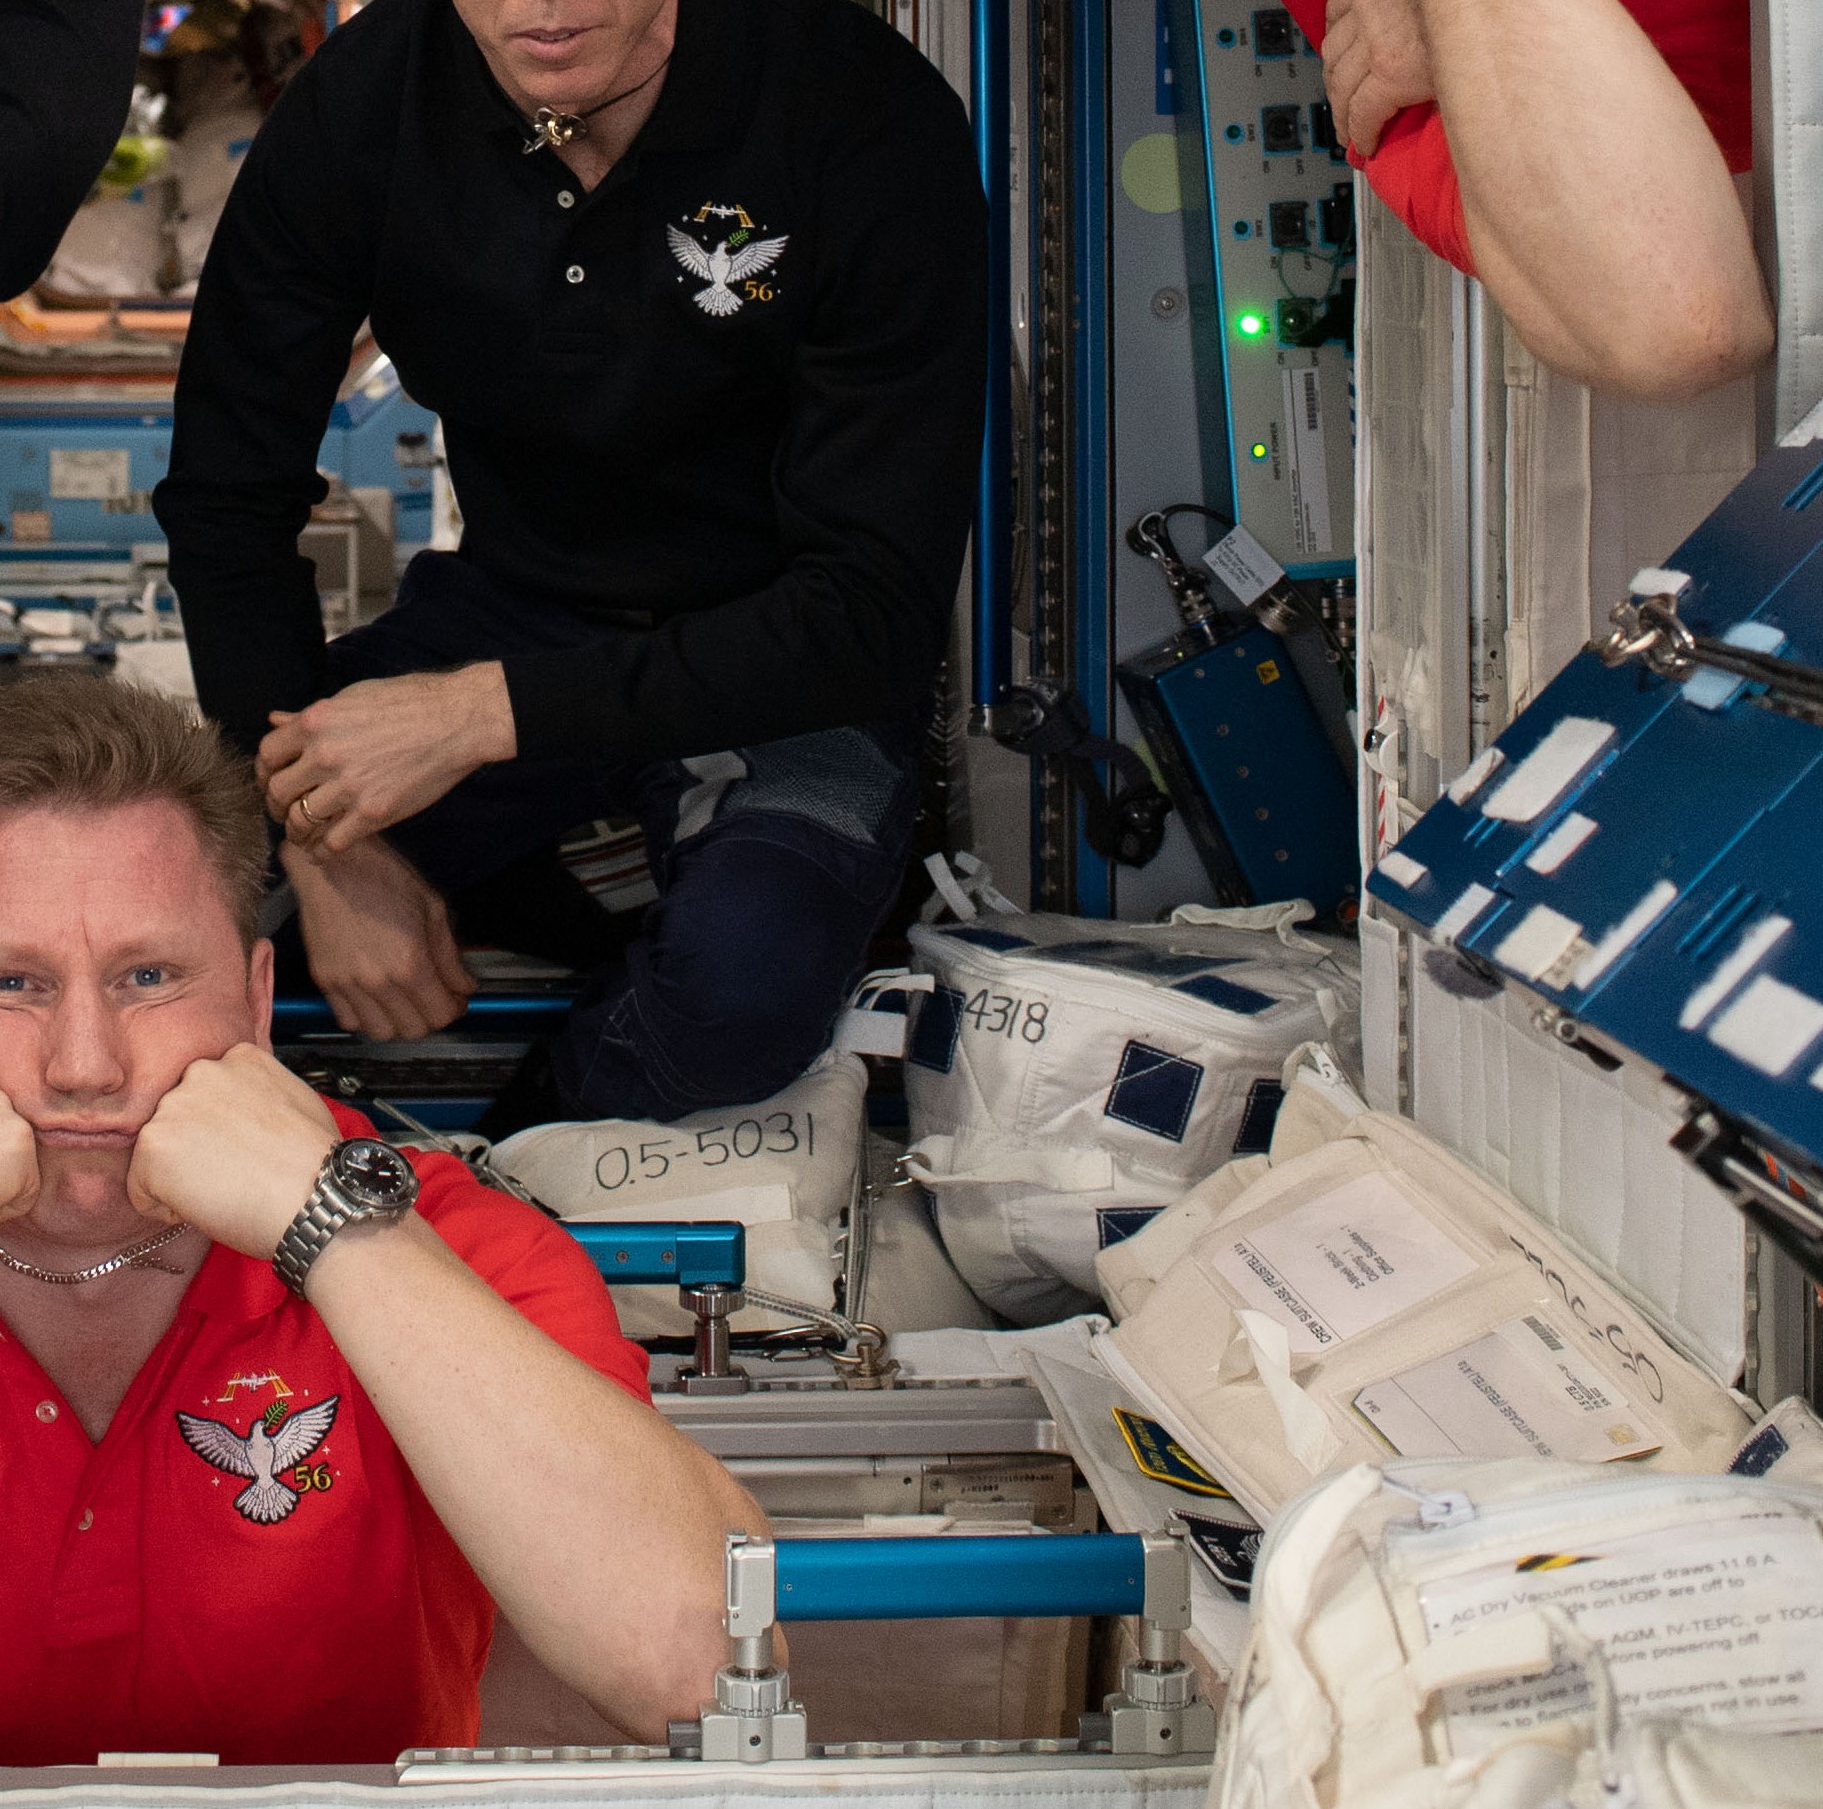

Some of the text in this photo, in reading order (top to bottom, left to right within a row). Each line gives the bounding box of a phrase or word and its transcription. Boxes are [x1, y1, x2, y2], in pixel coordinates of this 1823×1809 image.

[744, 280, 774, 303] 56
[1270, 421, 1280, 480] INPUT POWER
[965, 987, 1048, 1044] 4318
[595, 1112, 815, 1191] 0.5-5031
[1347, 1231, 1374, 1257] Supplies
[1242, 1250, 1282, 1290] (FEUSTEL)
[1370, 1254, 1394, 1274] Office
[1273, 1284, 1312, 1324] SUITCASE
[1304, 1317, 1332, 1345] CREW
[1498, 1402, 1540, 1444] SUITCASE
[295, 1463, 333, 1493] 56
[1479, 1596, 1512, 1617] Dry
[1512, 1581, 1586, 1608] Vacuum
[1589, 1568, 1658, 1594] Cleaner
[1661, 1560, 1714, 1582] draws
[1667, 1583, 1695, 1598] are
[1699, 1576, 1724, 1593] off
[1726, 1575, 1745, 1589] to
[1753, 1612, 1775, 1626] or
[1652, 1634, 1731, 1663] powering
[1735, 1629, 1761, 1645] off
[1738, 1671, 1779, 1692] stow
[1468, 1698, 1504, 1715] For
[1507, 1693, 1531, 1712] dry
[1709, 1696, 1740, 1714] not
[1765, 1690, 1800, 1708] use
